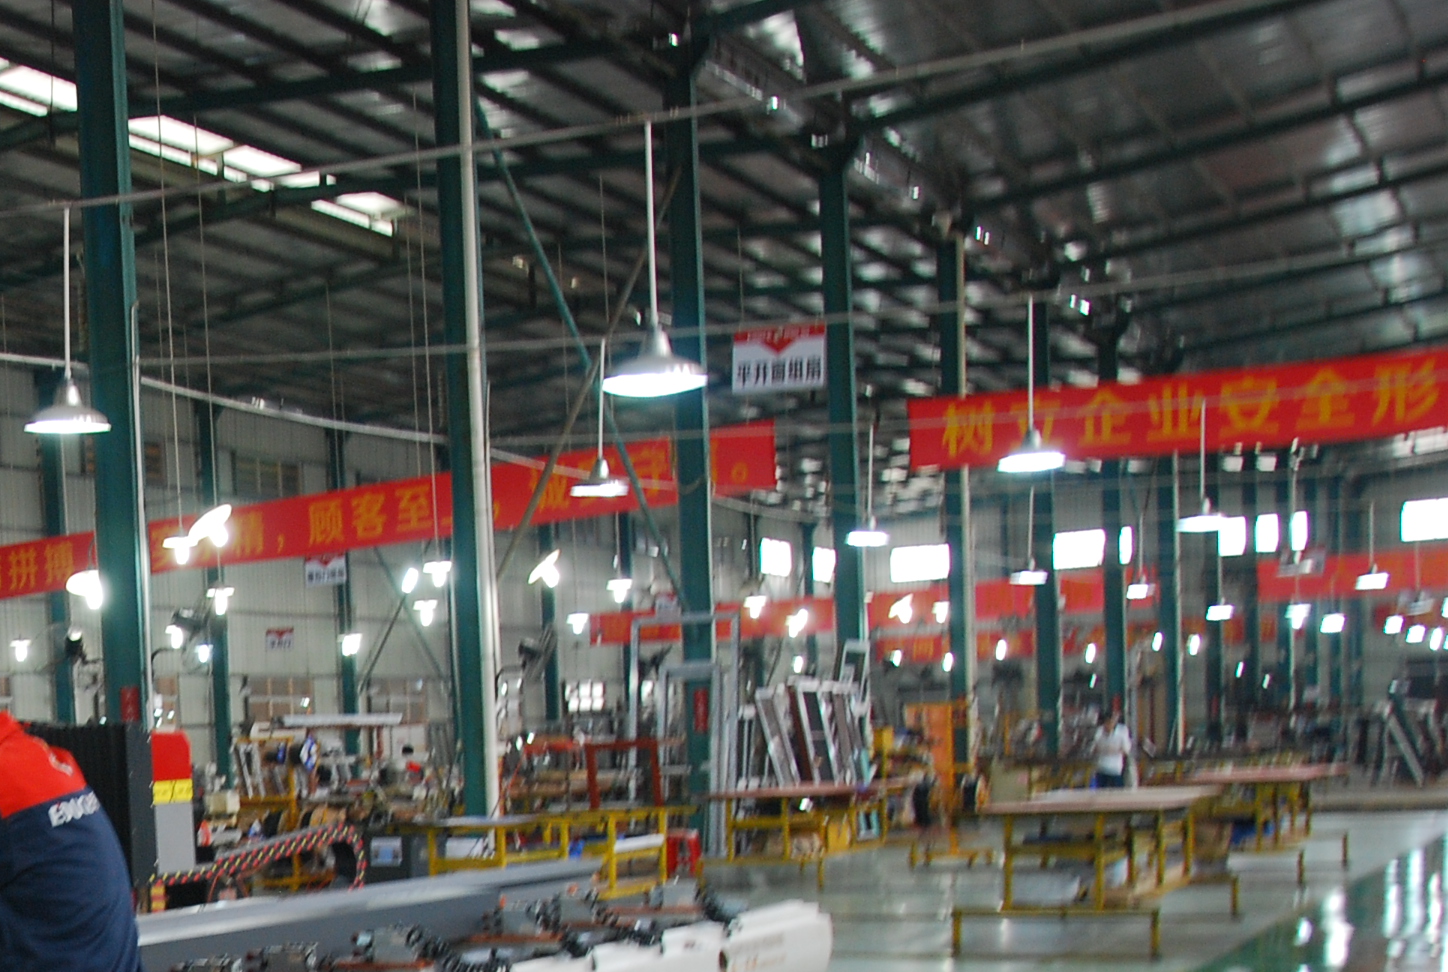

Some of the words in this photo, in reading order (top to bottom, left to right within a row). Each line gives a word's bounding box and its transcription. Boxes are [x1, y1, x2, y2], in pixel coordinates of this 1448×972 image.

[943, 359, 1440, 457] 树立企业安全形
